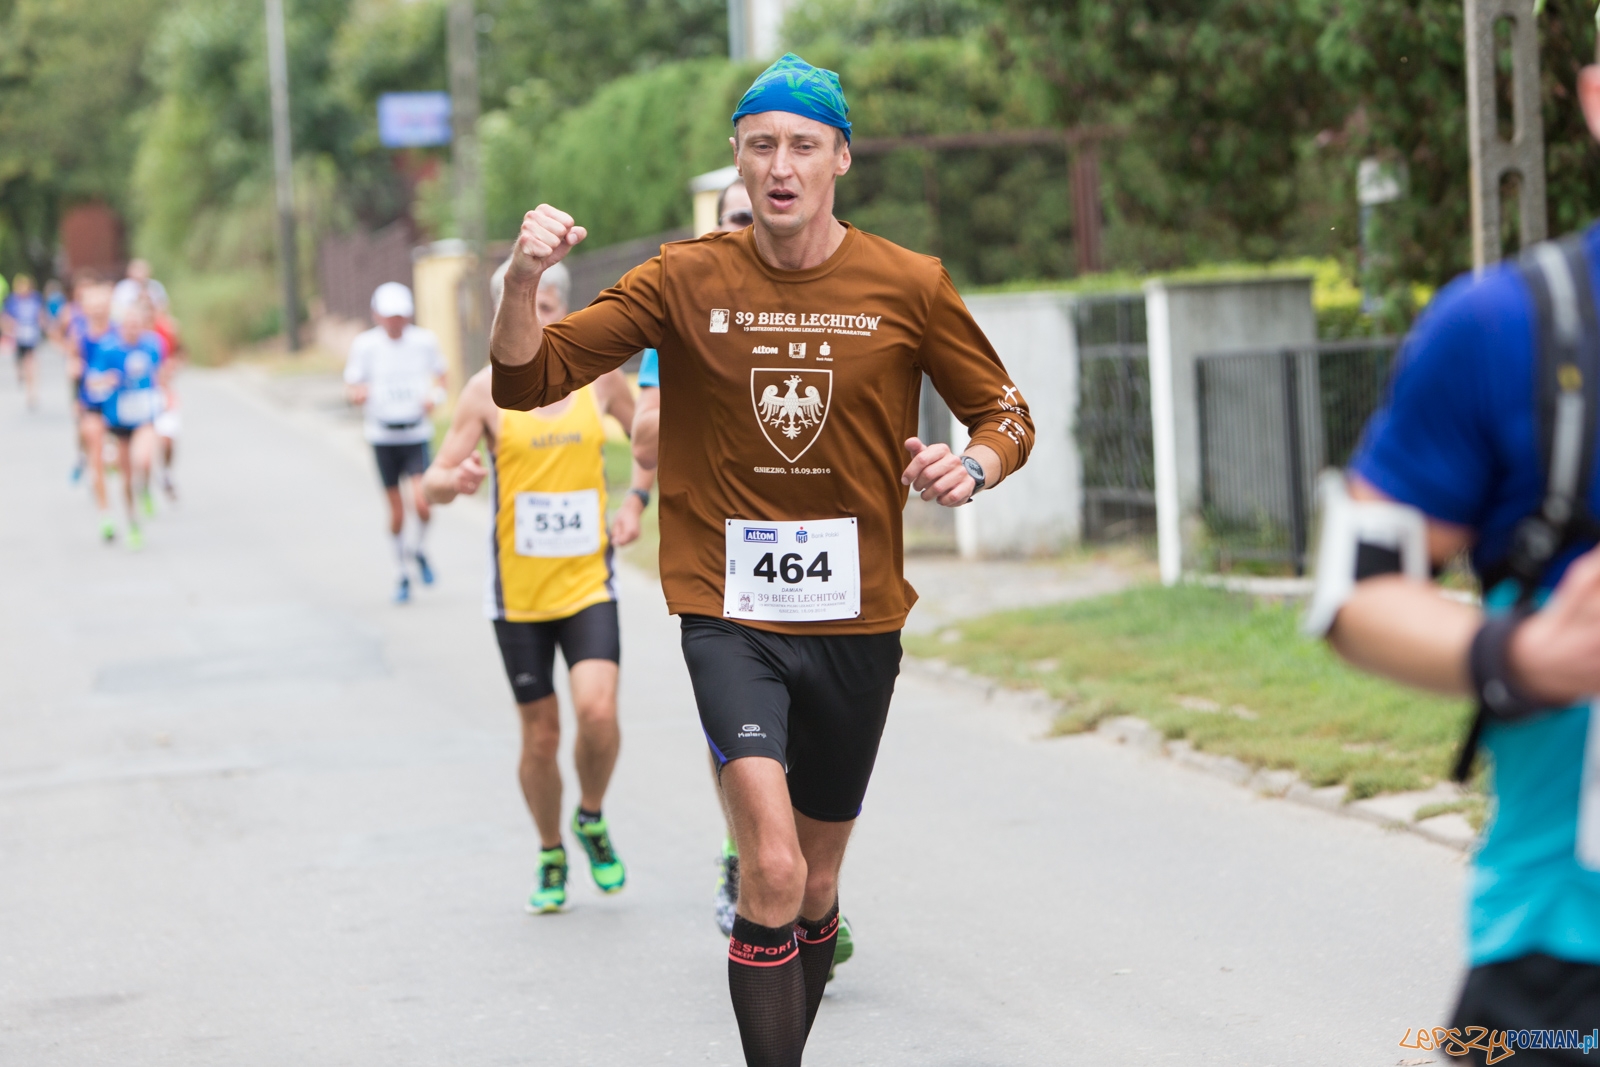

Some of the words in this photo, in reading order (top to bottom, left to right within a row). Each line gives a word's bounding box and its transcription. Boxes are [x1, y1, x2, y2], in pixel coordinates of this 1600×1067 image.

[735, 311, 755, 326] 39
[758, 312, 796, 326] BIEG
[800, 313, 882, 330] LECHITÓW
[790, 467, 831, 475] 18.09.2016
[535, 512, 582, 533] 534
[753, 551, 832, 584] 464
[757, 593, 770, 603] 39
[772, 594, 795, 603] BIEG
[798, 590, 847, 603] LECHITÓW
